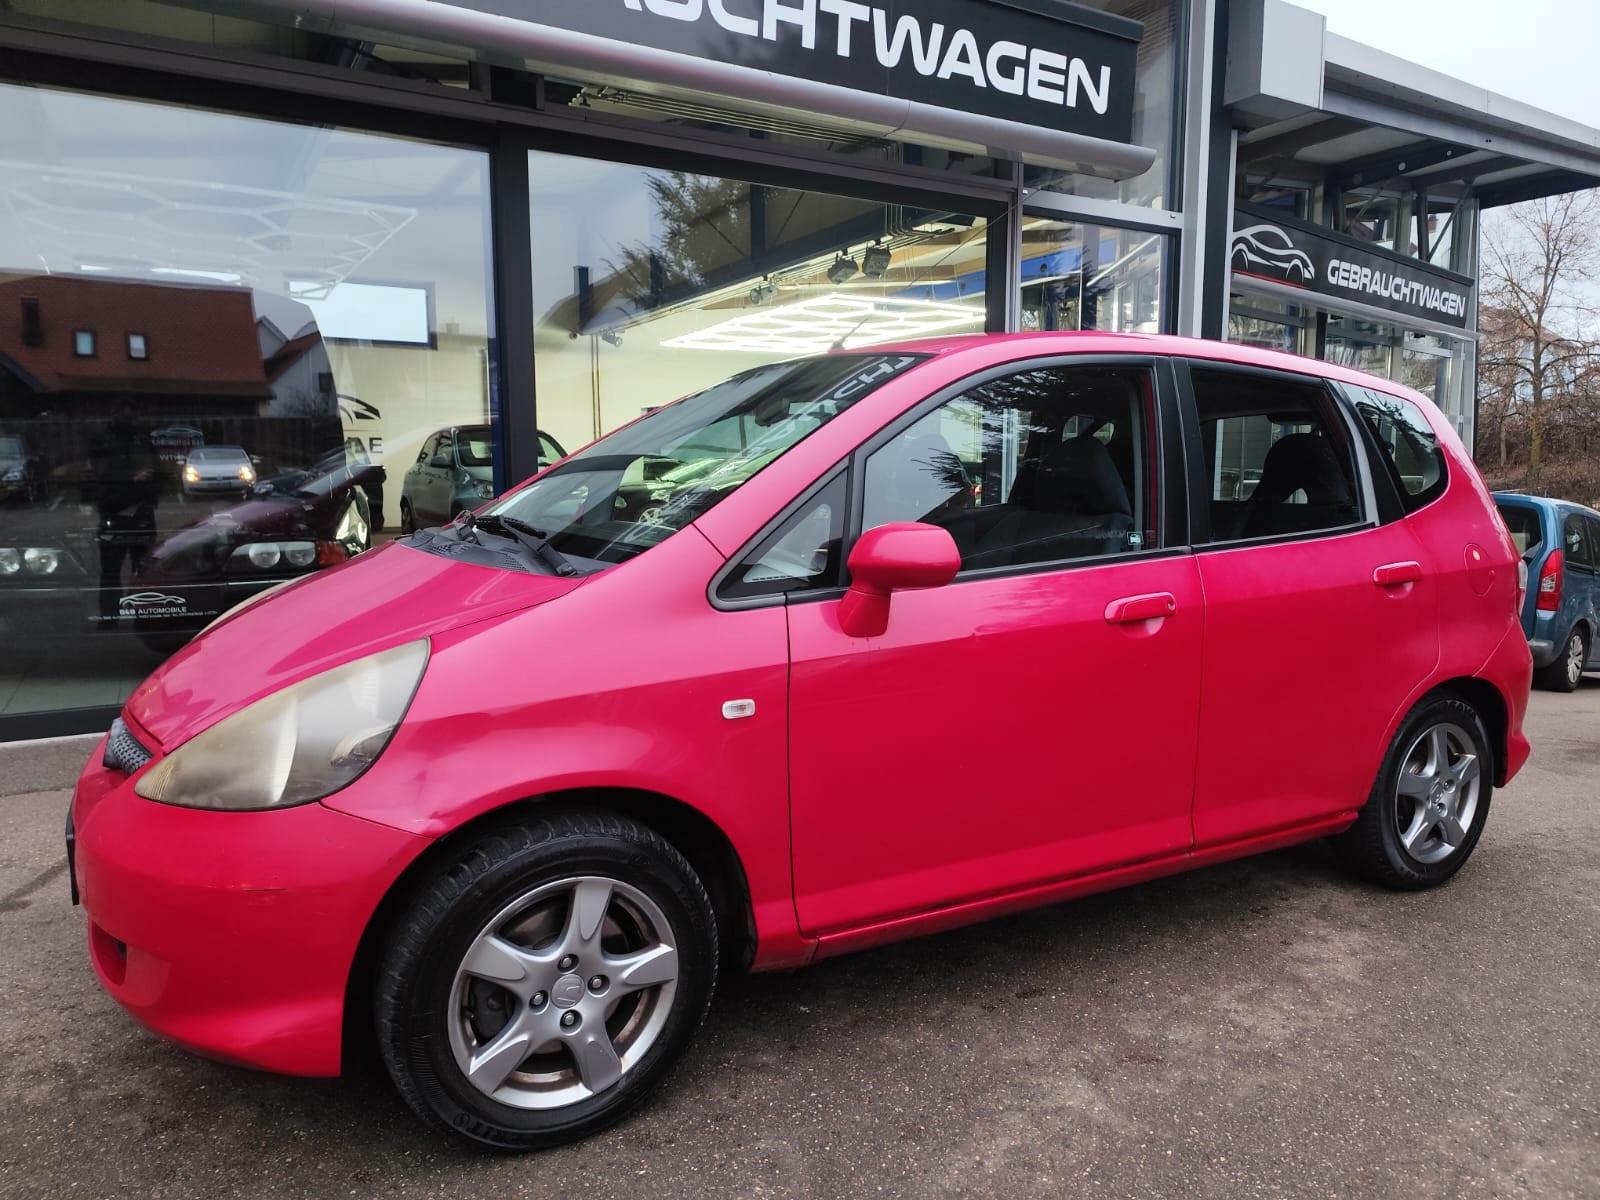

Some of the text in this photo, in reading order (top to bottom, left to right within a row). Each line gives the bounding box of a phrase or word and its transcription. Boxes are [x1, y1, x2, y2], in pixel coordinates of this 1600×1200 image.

[624, 0, 1111, 115] CHTWAGEN
[1327, 258, 1466, 318] GEBRAUCHTWAGEN
[137, 606, 187, 615] AUTOMOBILE
